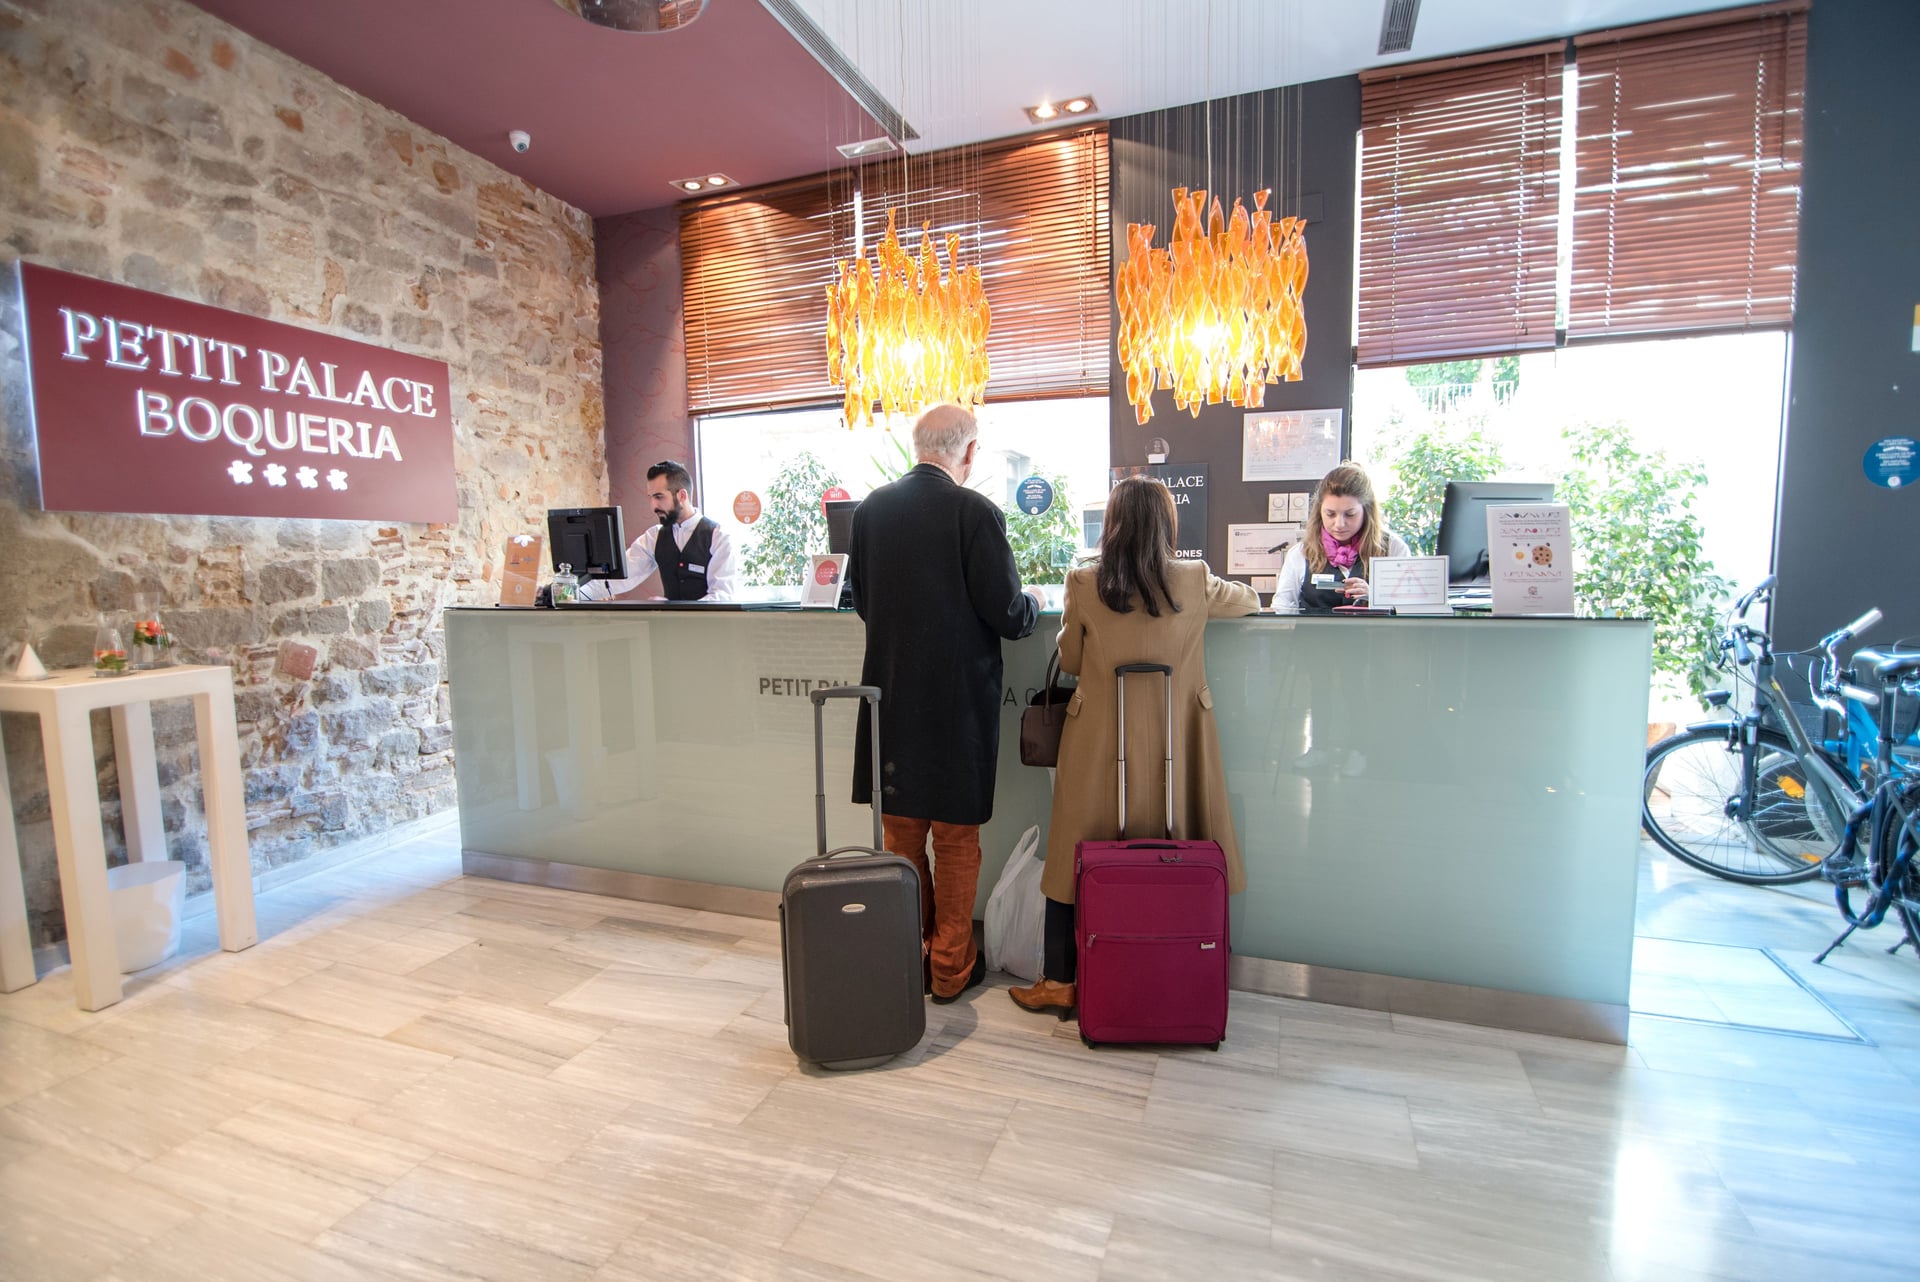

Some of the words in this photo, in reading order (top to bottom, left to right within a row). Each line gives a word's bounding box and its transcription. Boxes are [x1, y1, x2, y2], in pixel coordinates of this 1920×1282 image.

[58, 306, 247, 385] PETIT
[257, 349, 437, 418] PALACE
[136, 387, 403, 461] BOQUERIA
[1156, 475, 1204, 488] ALACE
[760, 677, 812, 697] PETIT
